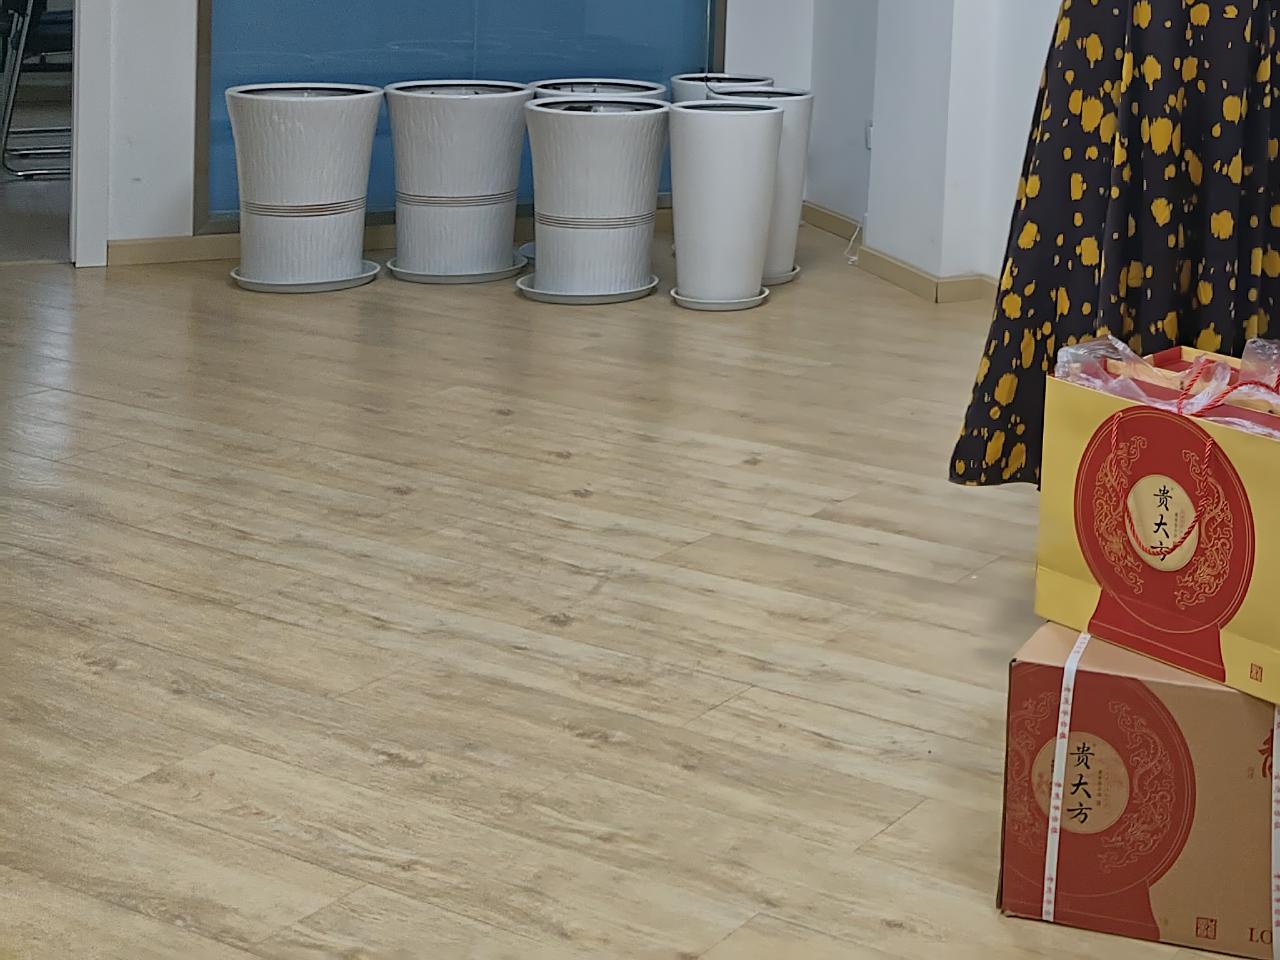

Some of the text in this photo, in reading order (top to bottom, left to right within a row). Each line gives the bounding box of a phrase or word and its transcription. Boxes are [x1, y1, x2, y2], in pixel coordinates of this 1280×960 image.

[1150, 484, 1174, 562] 贵大方
[1066, 741, 1096, 824] 贵大方
